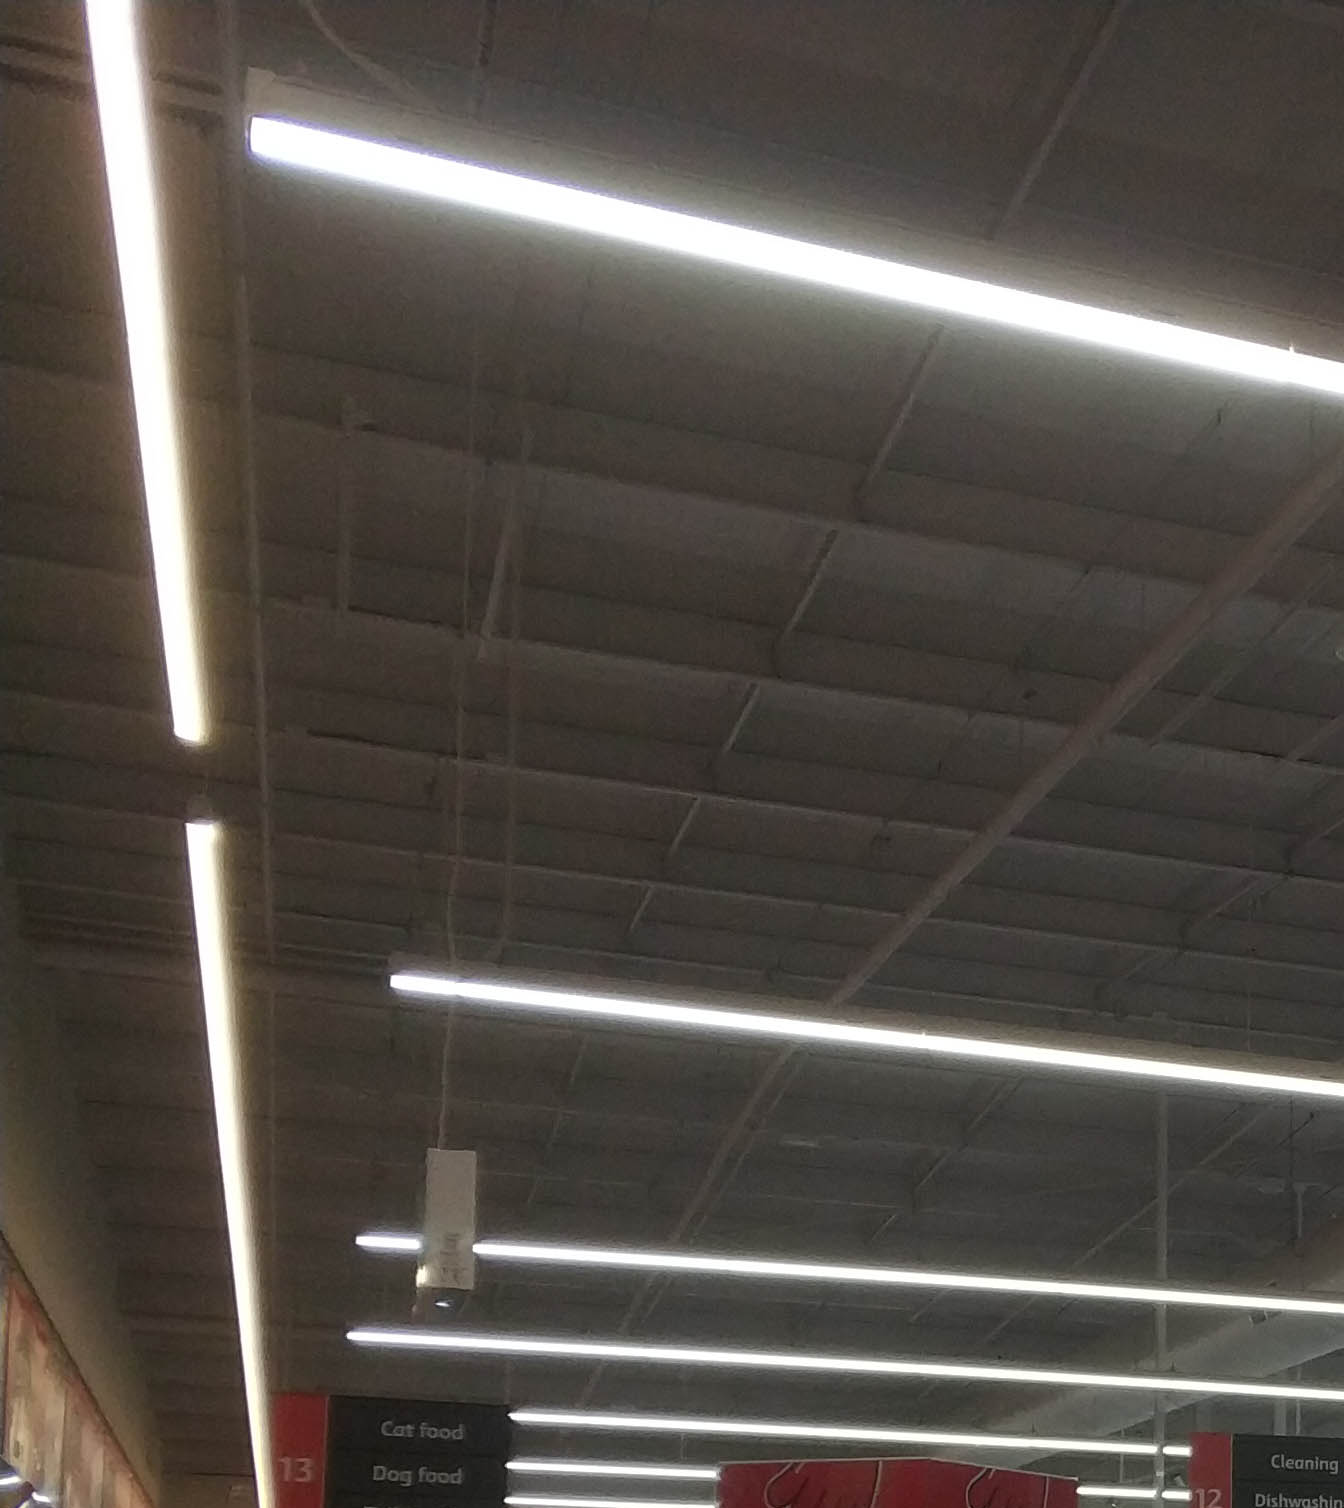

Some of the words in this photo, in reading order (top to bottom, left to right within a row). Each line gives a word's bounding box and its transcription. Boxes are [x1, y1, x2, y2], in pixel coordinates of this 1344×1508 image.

[381, 1421, 415, 1437] Cat
[420, 1423, 464, 1440] food
[279, 1457, 314, 1482] 13
[1270, 1453, 1339, 1475] Cleaning
[372, 1465, 412, 1486] Dog
[418, 1466, 463, 1485] food
